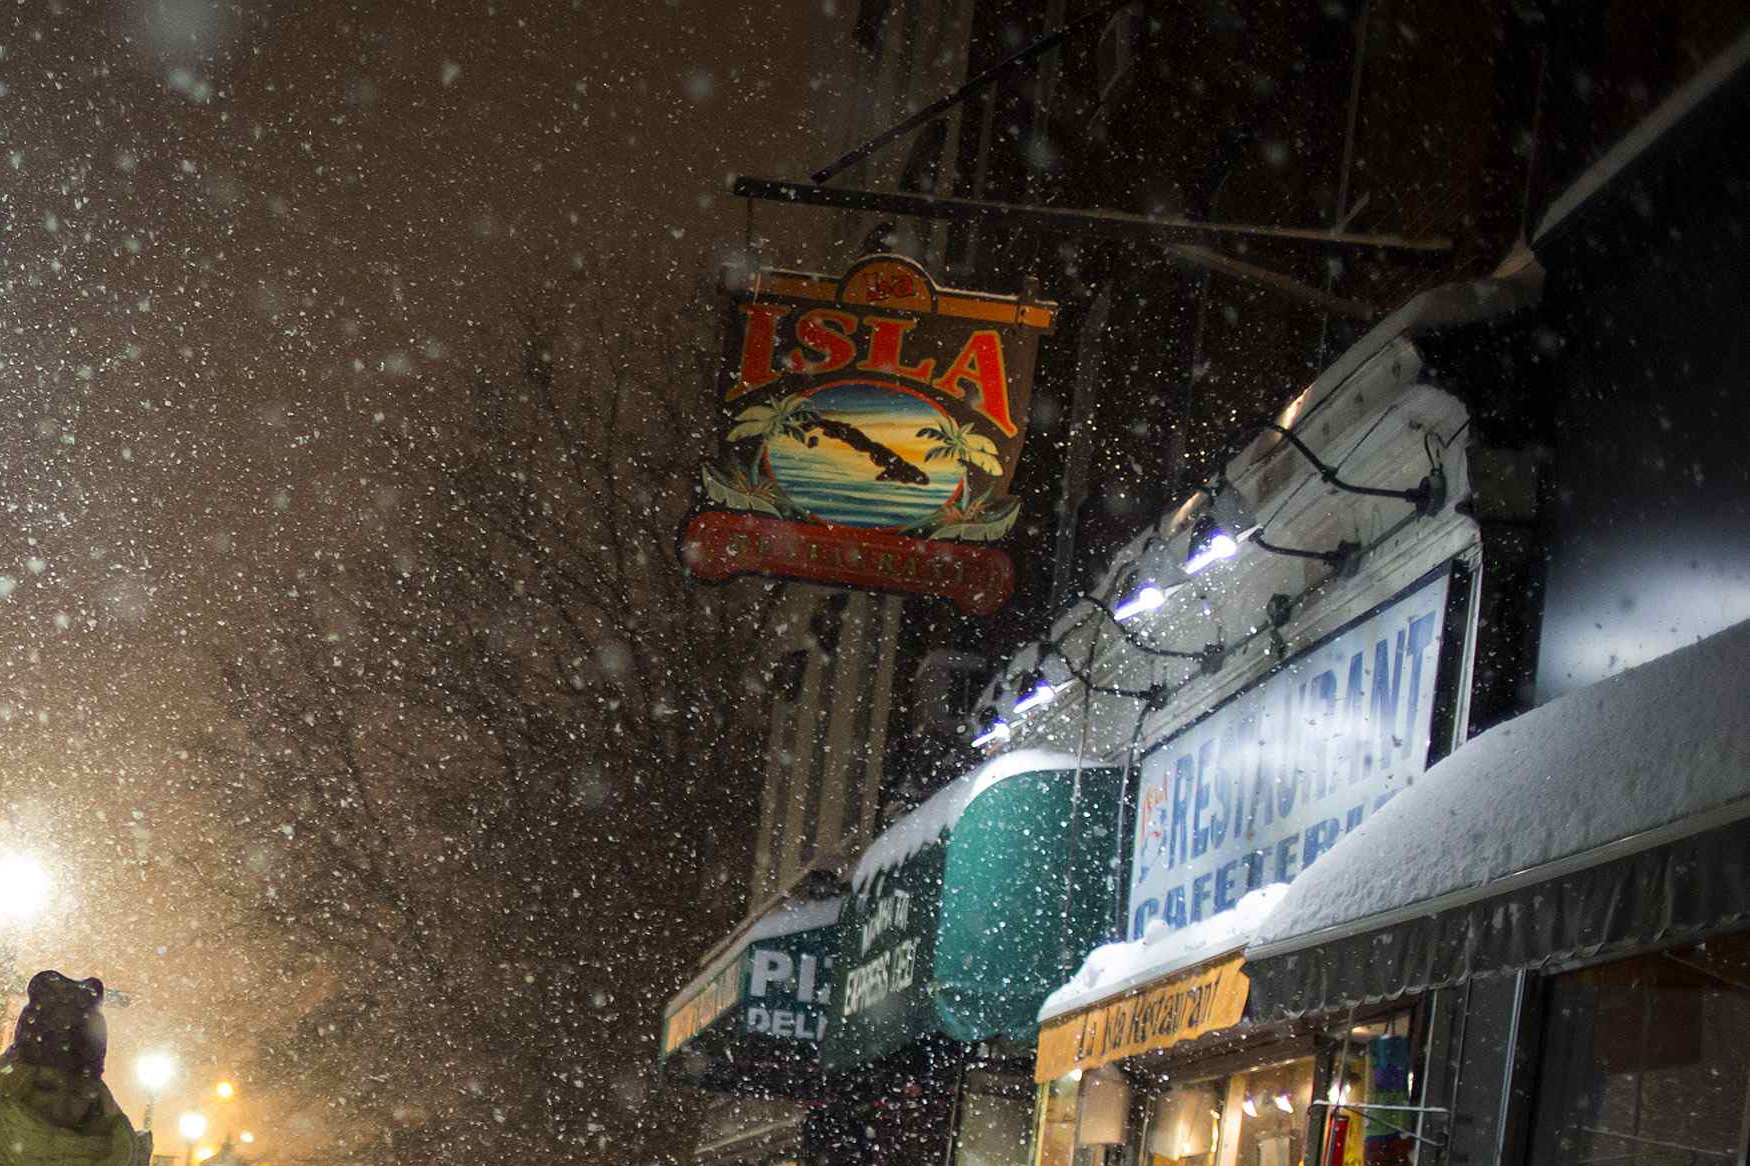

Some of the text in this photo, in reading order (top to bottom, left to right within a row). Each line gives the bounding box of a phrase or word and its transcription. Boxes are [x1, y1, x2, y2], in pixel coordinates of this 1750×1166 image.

[725, 303, 1019, 439] ISLA
[1168, 610, 1437, 870] RESTAURANT
[1133, 787, 1404, 941] CAFETER
[748, 1007, 828, 1041] DELI
